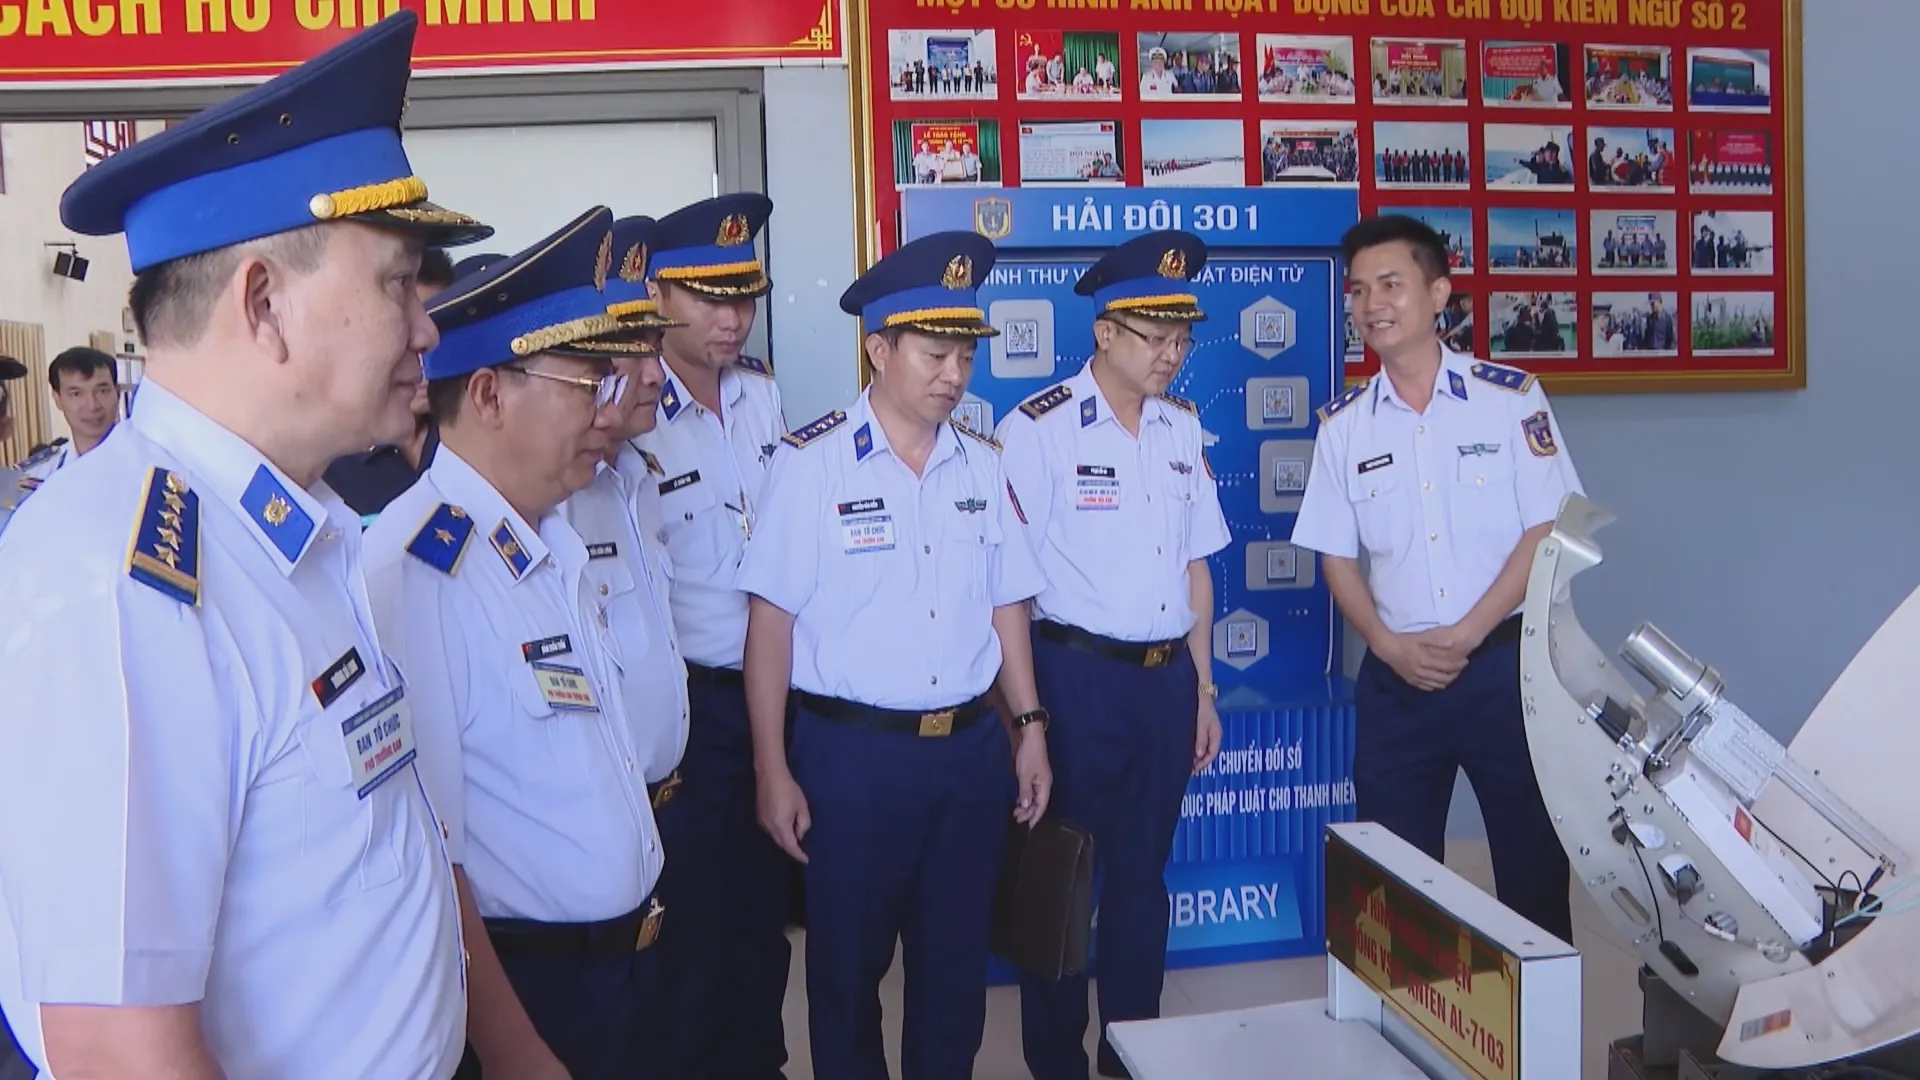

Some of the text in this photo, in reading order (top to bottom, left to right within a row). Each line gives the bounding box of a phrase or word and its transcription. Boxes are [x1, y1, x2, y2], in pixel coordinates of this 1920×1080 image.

[1731, 2, 1746, 30] 2
[1052, 197, 1113, 231] HẢI
[1193, 204, 1259, 230] 301
[1027, 267, 1068, 285] THƯ
[1231, 263, 1273, 287] ĐIỆN
[1278, 262, 1305, 284] TỬ
[1219, 739, 1263, 776] CHUYỂN
[1264, 737, 1284, 772] ĐỔI
[1287, 737, 1302, 770] SỐ
[1206, 786, 1236, 817] PHÁP
[1239, 783, 1266, 817] LUẬT
[1268, 787, 1291, 811] CHO
[1293, 783, 1330, 809] THANH
[1168, 882, 1279, 929] IBRARY
[1450, 1003, 1504, 1071] AL-7103
